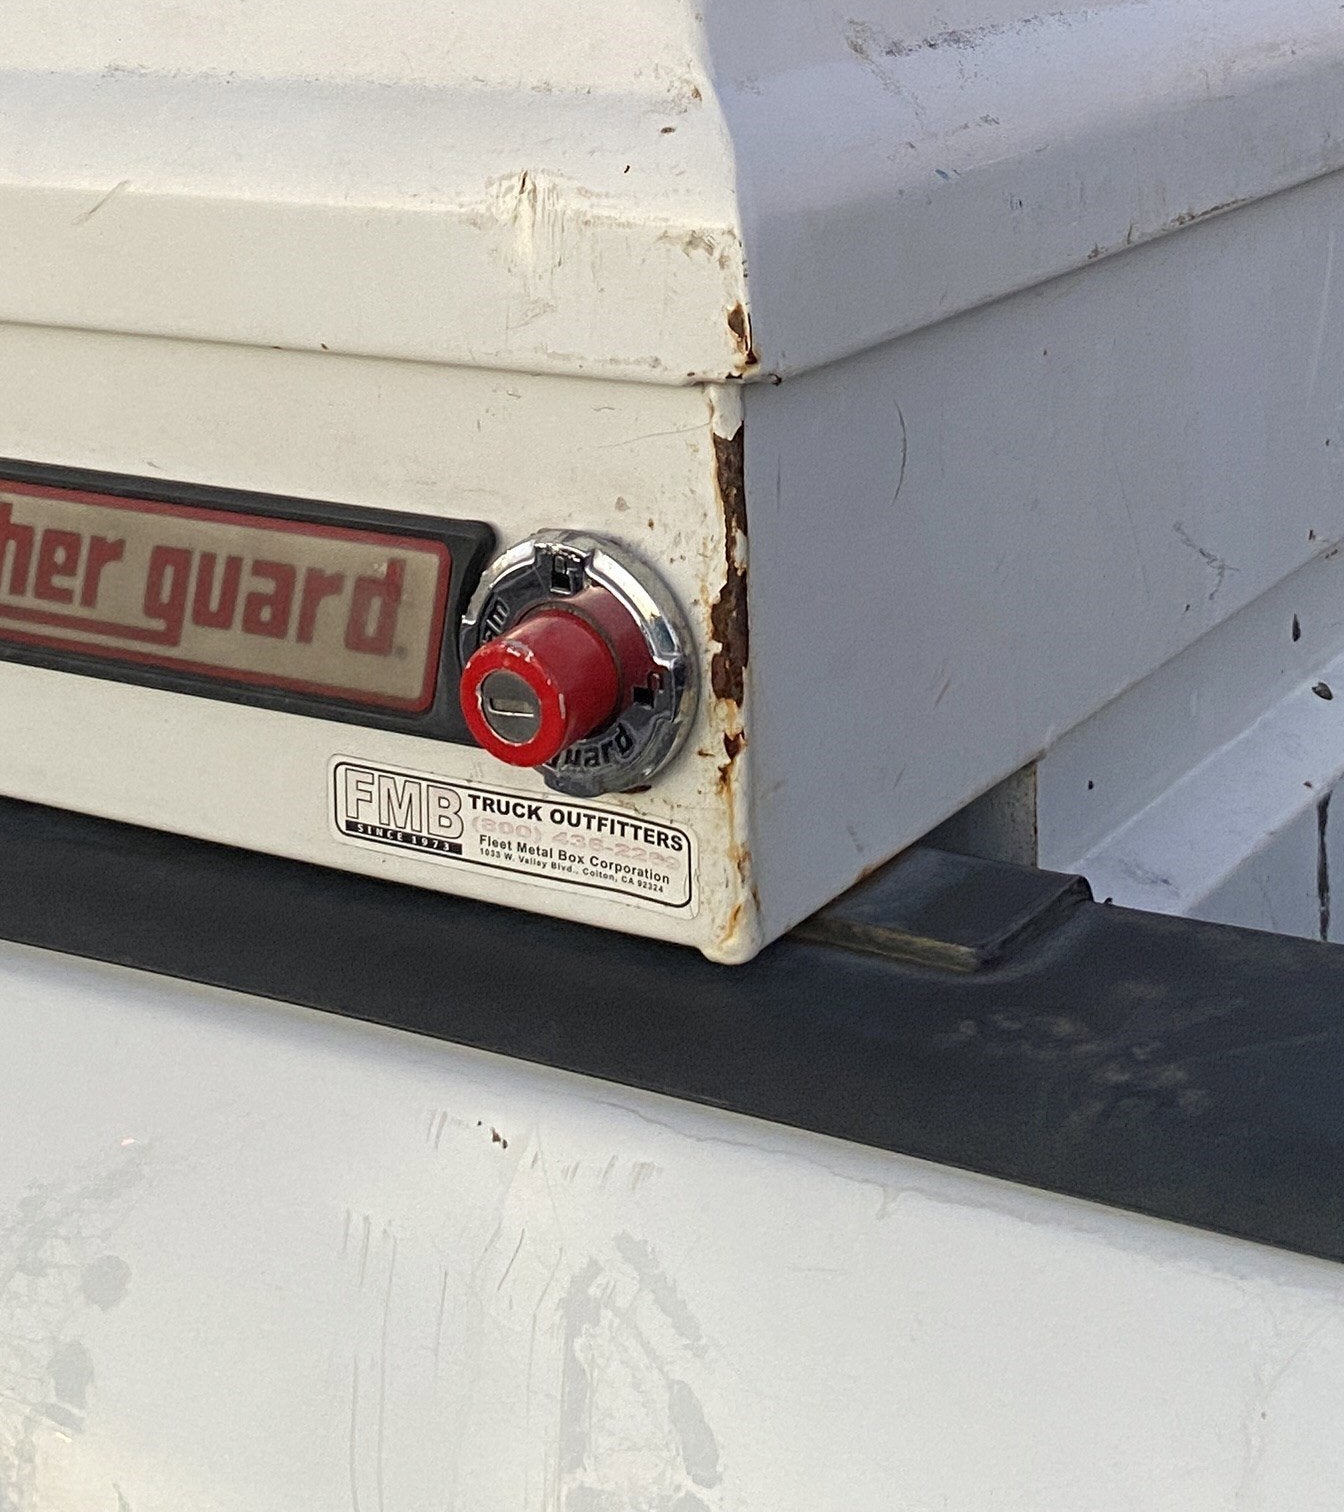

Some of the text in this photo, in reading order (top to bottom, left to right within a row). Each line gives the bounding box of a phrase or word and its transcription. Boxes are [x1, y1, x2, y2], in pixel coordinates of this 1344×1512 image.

[143, 543, 406, 657] guard
[345, 768, 464, 840] FMB
[468, 793, 684, 852] TRUCK OUTFITTERS
[357, 823, 451, 852] SINCE 1973
[479, 834, 671, 885] Fleet Metal Box Corporation
[480, 847, 502, 859] 1033
[518, 855, 548, 869] Valley
[621, 875, 635, 886] CA
